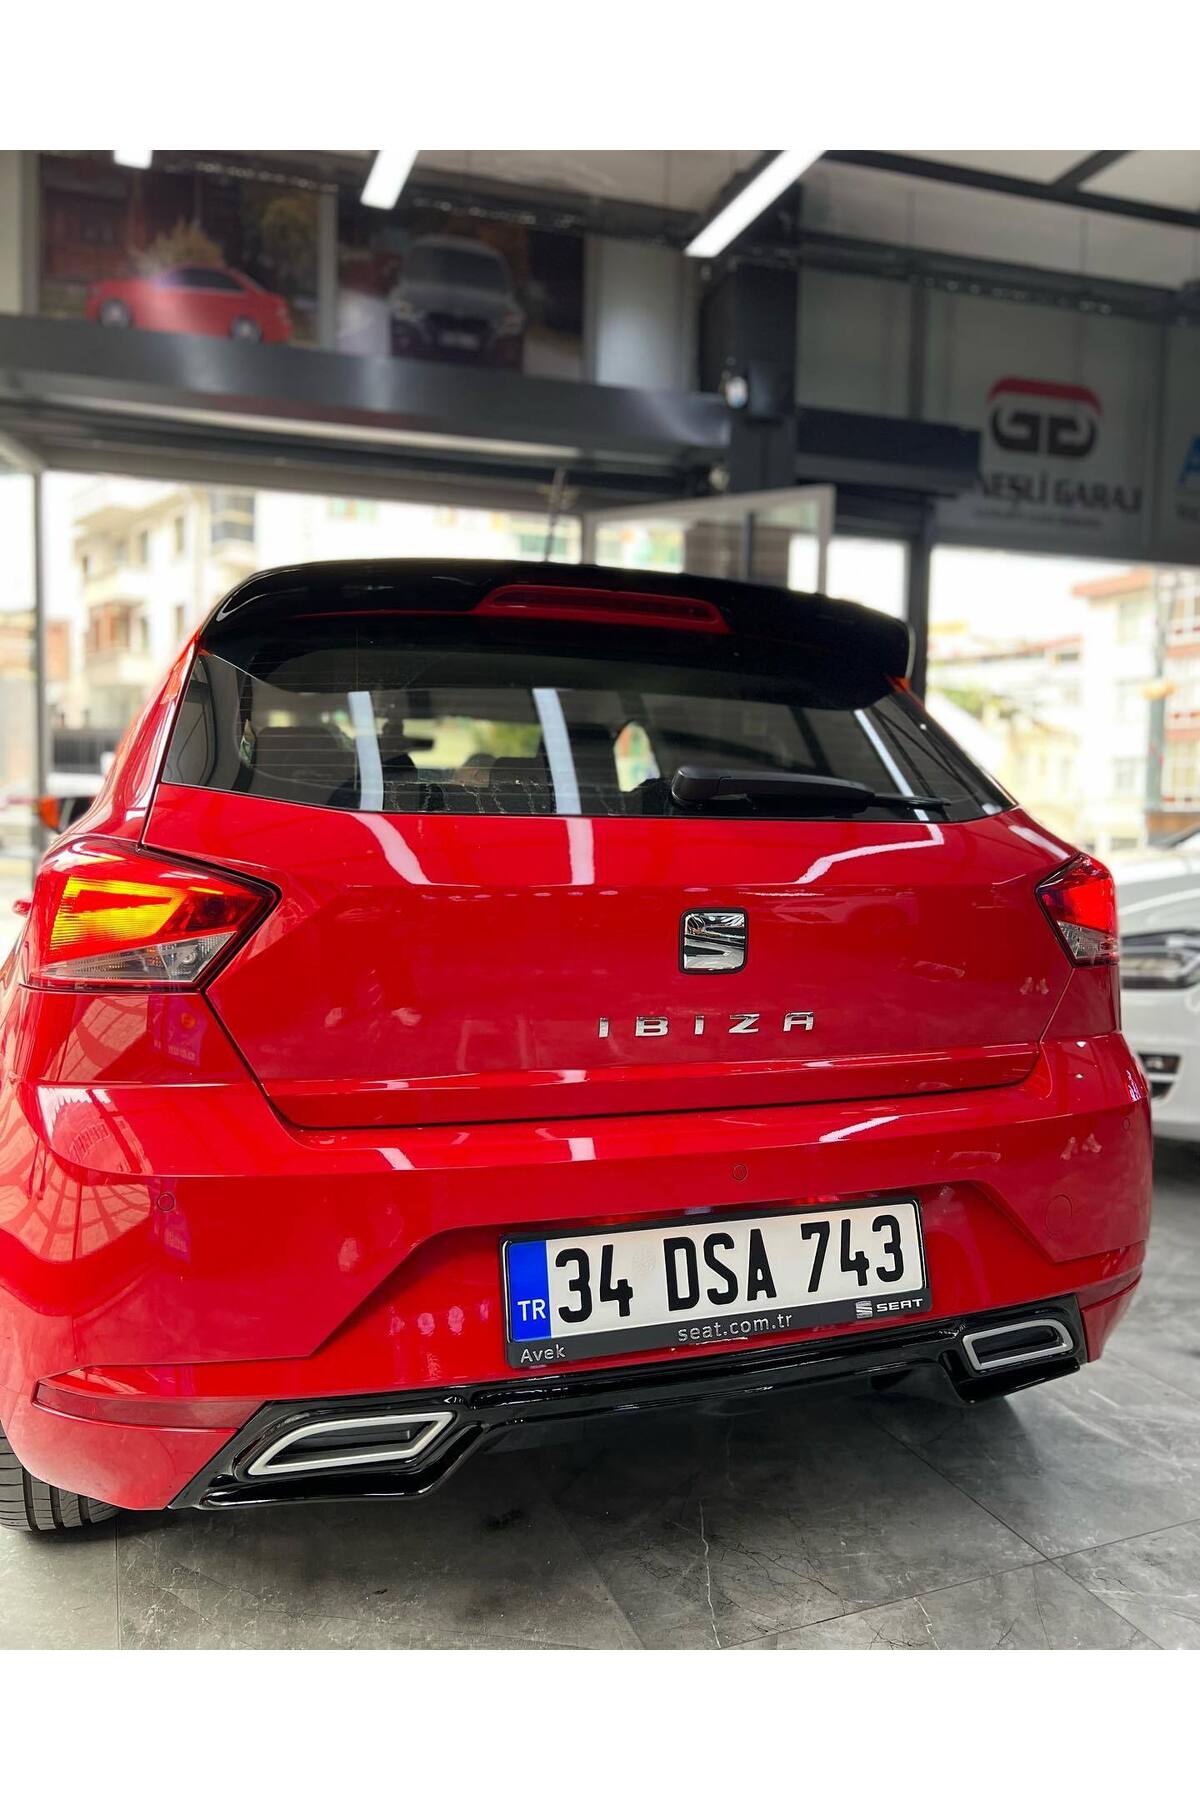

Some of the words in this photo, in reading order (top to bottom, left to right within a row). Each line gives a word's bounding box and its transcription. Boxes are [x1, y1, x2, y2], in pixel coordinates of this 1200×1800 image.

[1054, 477, 1143, 515] GARAJ
[598, 1011, 814, 1038] IBIZA
[517, 1299, 546, 1321] TR
[555, 1244, 634, 1323] 34
[663, 1228, 777, 1312] DSA
[800, 1214, 904, 1293] 743
[876, 1298, 924, 1313] SEAT
[678, 1312, 793, 1342] seat.com.tr
[520, 1344, 566, 1363] Avek
